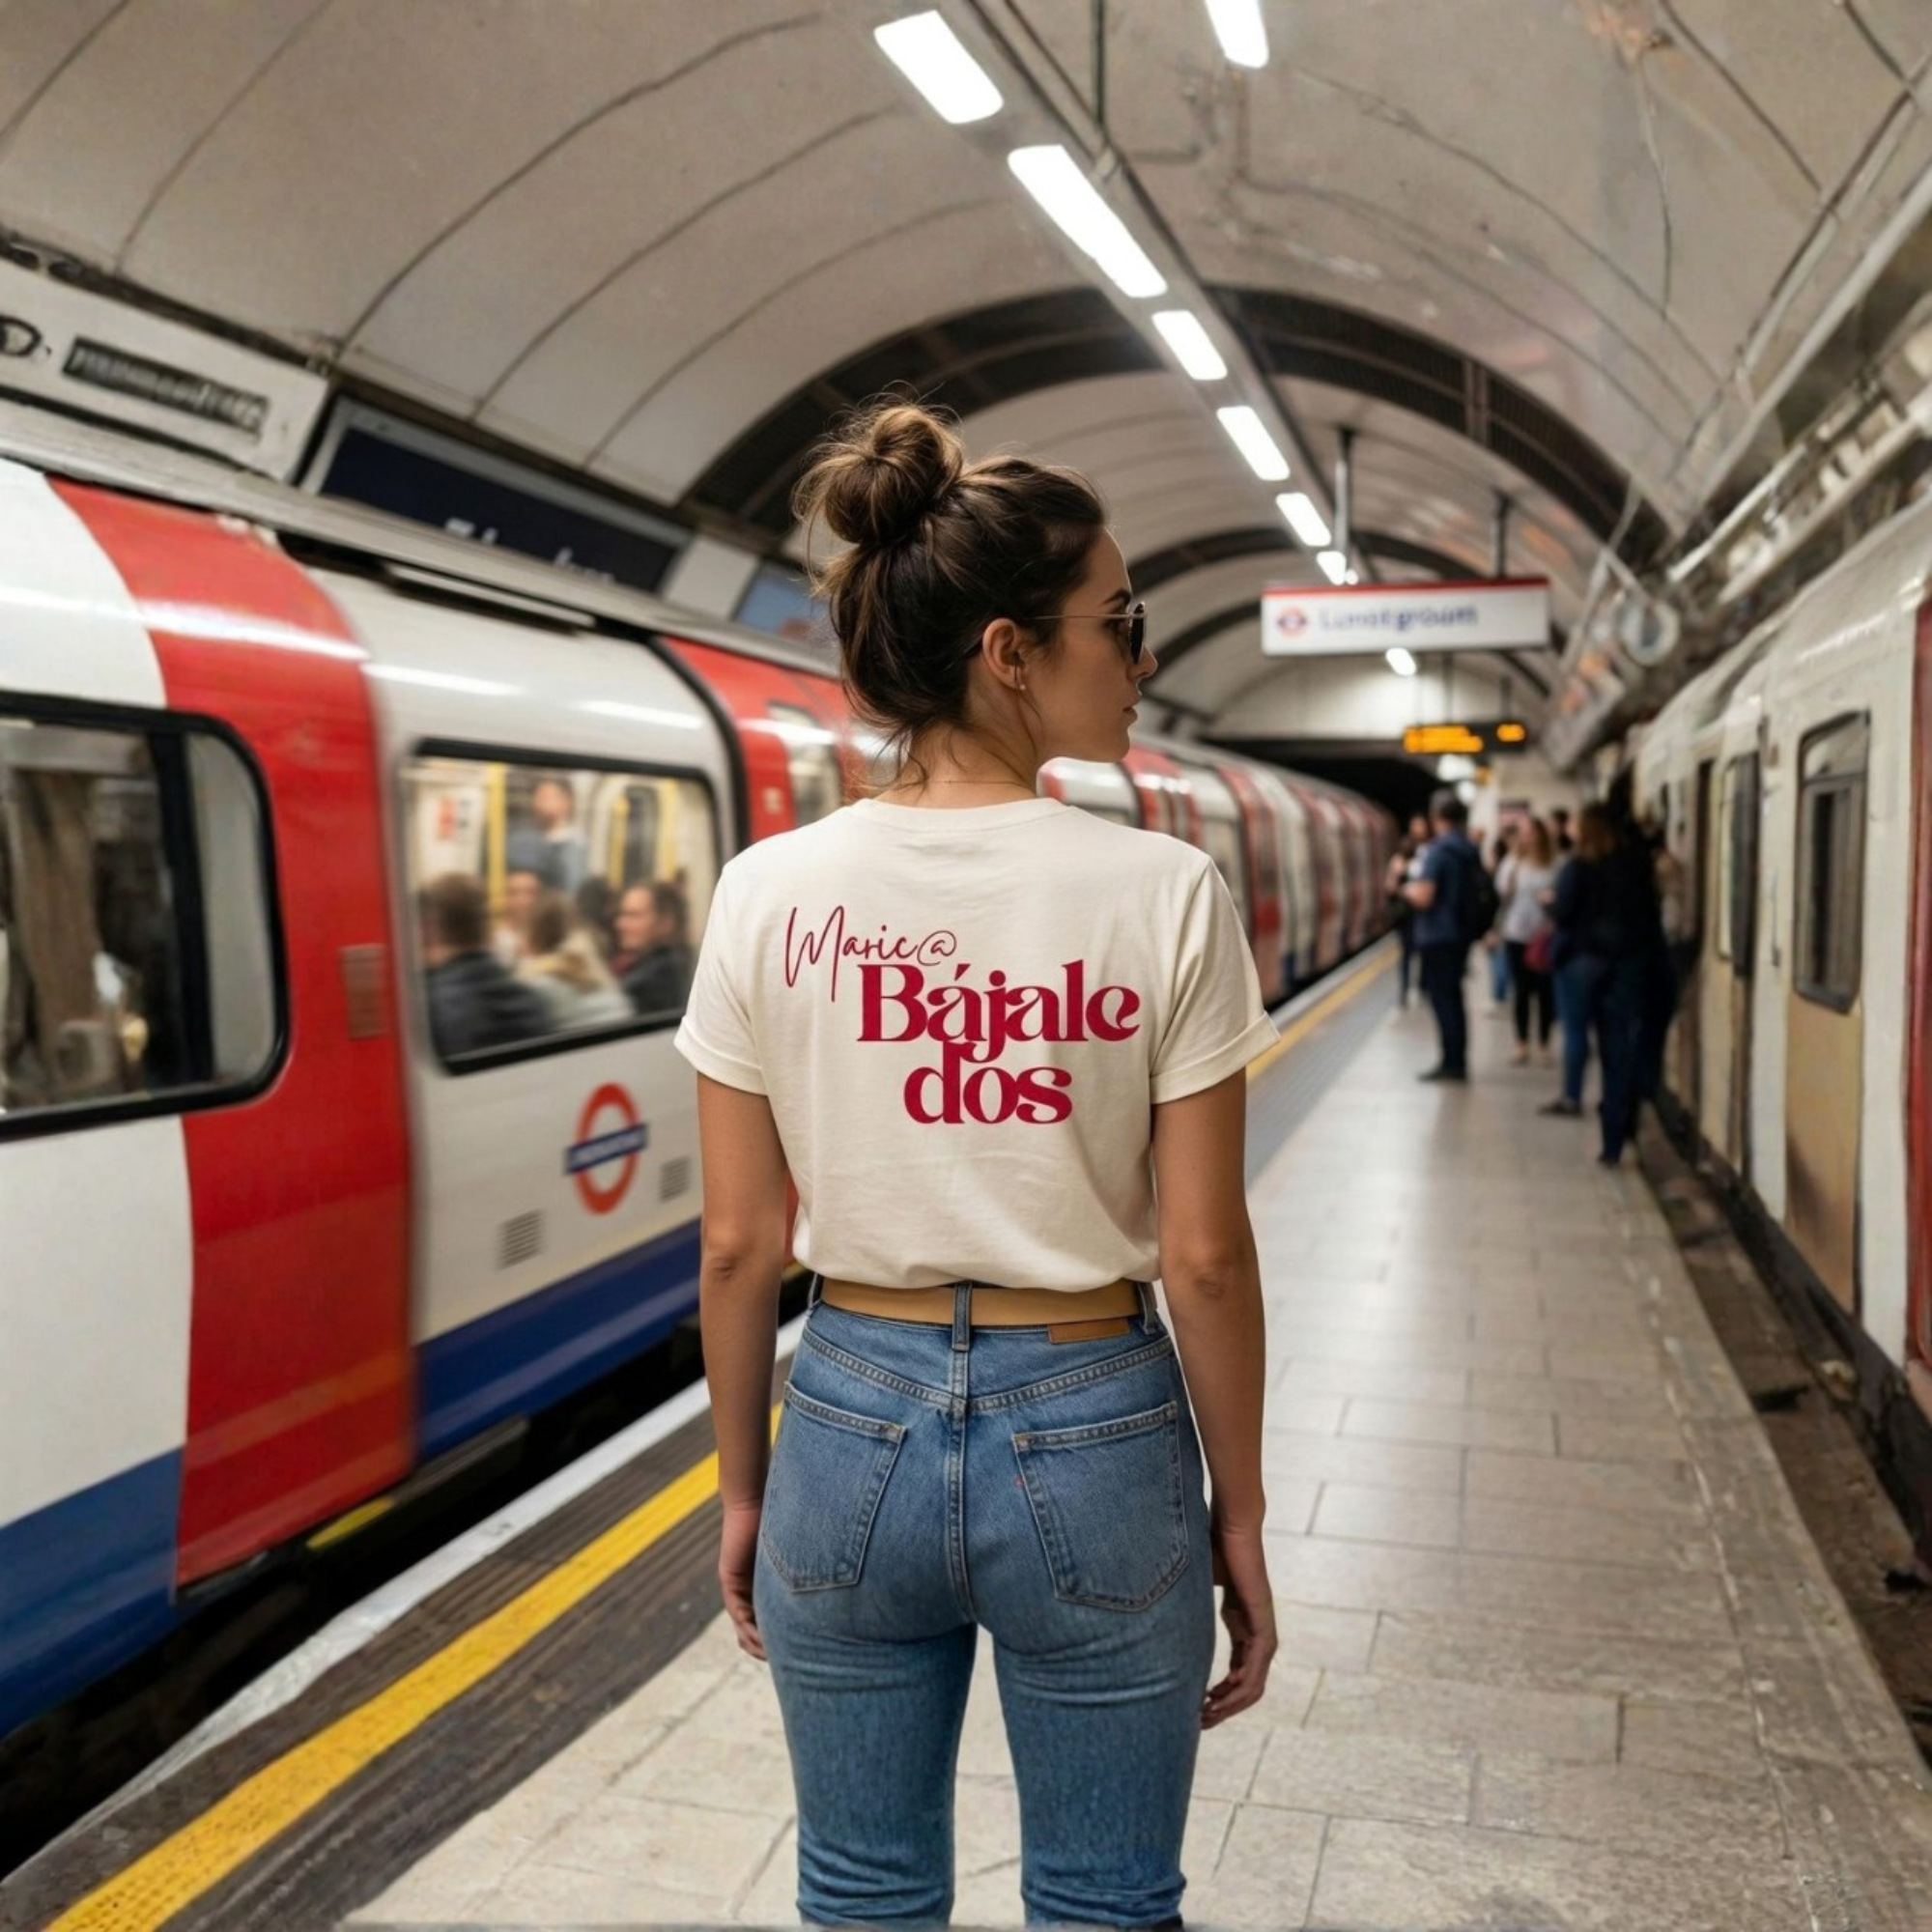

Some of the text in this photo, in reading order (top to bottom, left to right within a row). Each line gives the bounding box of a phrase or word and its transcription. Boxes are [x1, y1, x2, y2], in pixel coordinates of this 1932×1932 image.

[784, 905, 957, 1002] Maric@
[857, 959, 1141, 1063] Bájale
[903, 1041, 1073, 1124] dos
